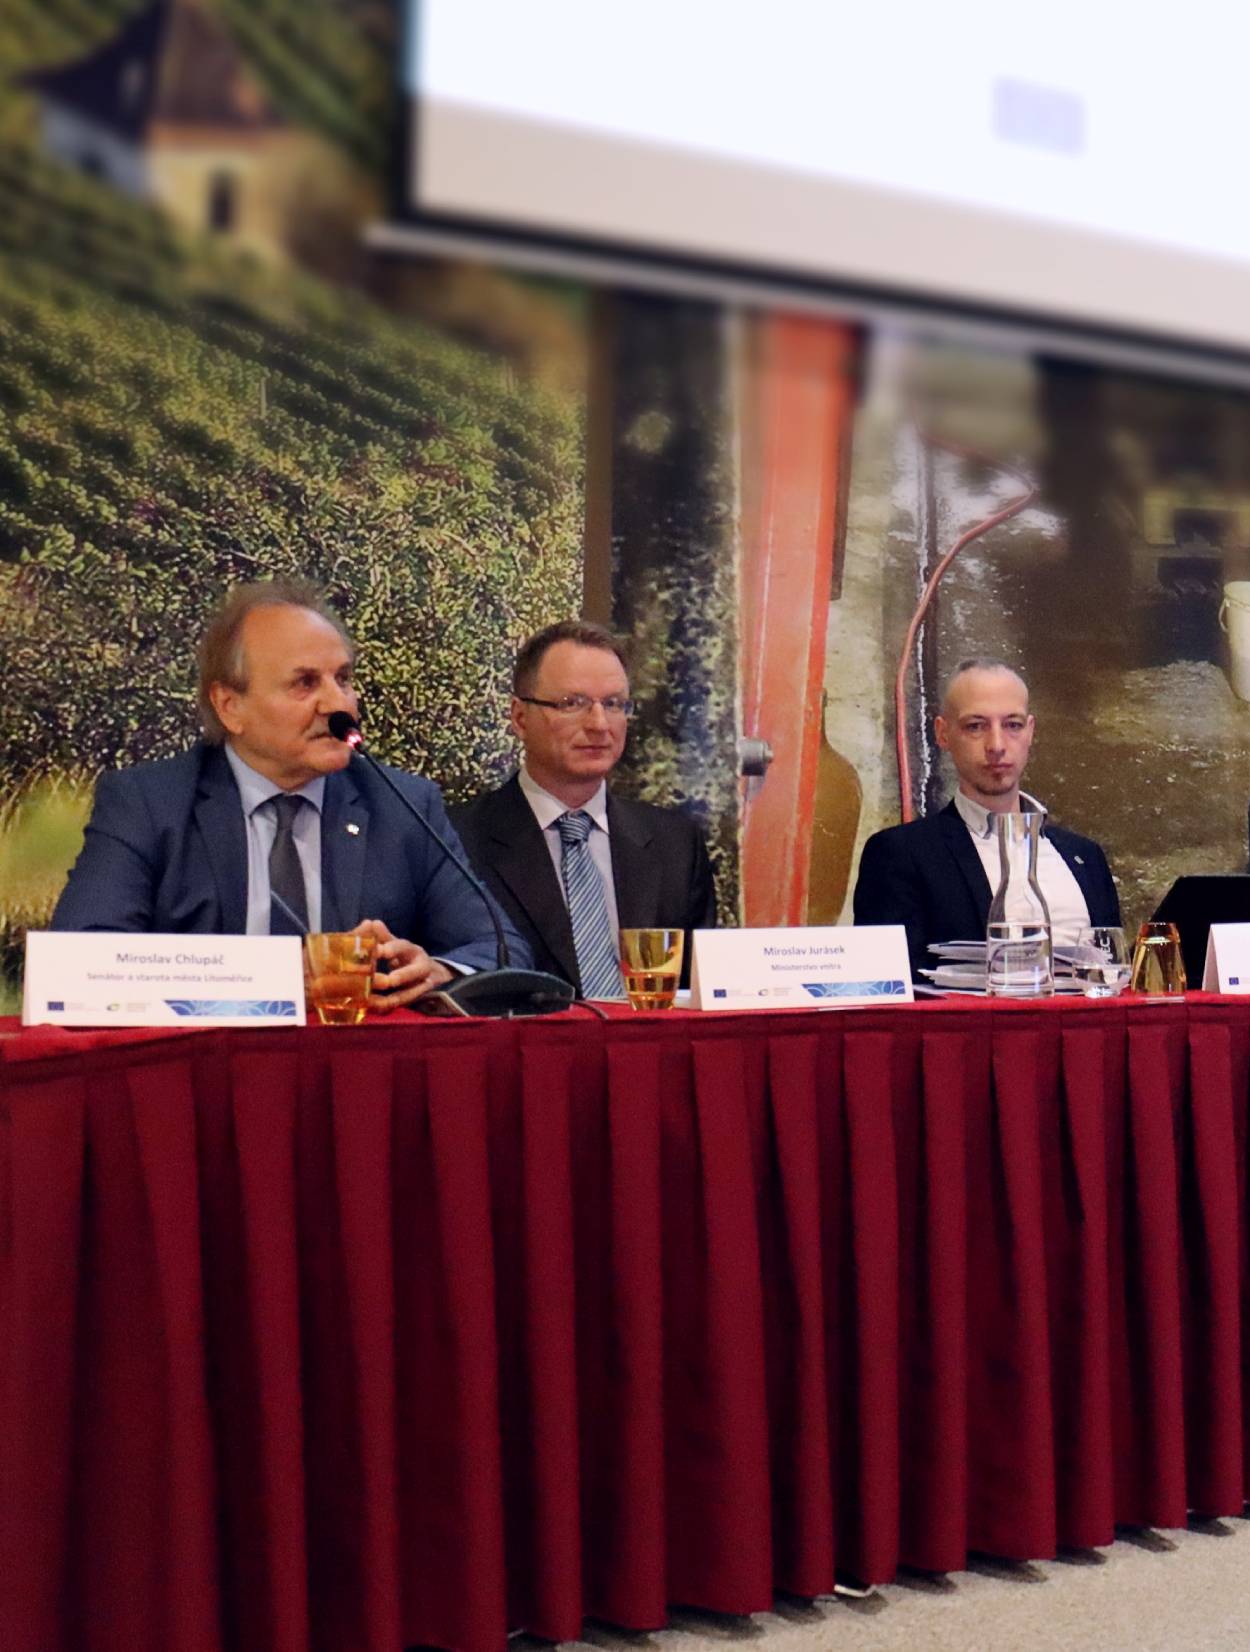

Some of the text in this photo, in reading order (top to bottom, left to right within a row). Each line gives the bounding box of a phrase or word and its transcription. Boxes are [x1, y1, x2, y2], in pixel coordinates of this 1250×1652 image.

[763, 945, 845, 956] Miroslav Jurásek
[116, 952, 225, 967] Miroslav Chlupáč
